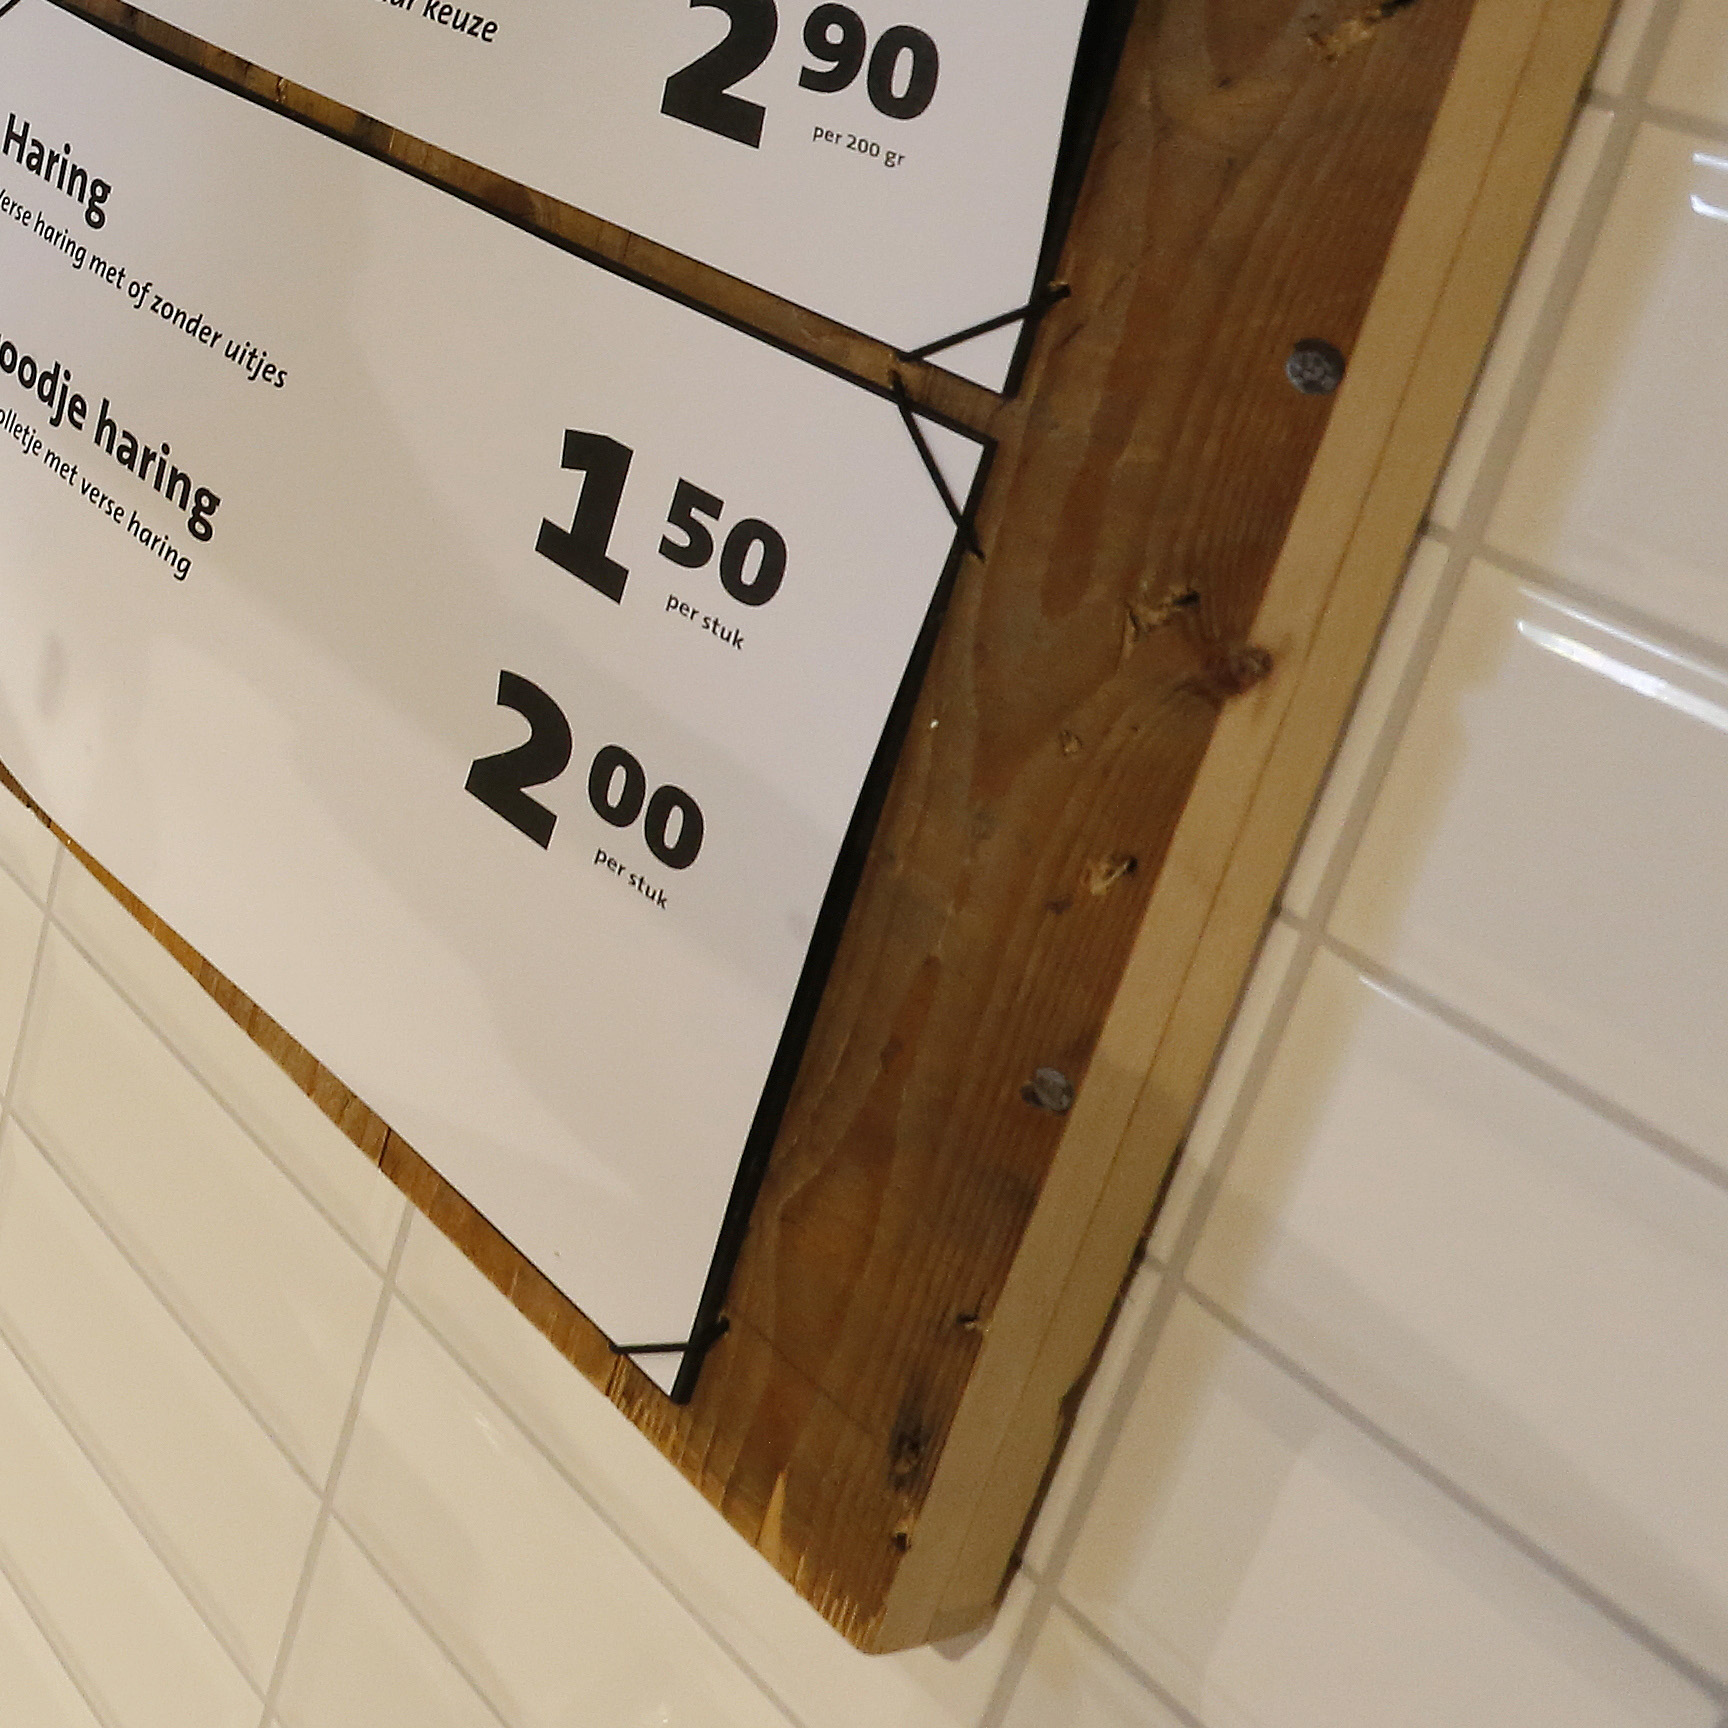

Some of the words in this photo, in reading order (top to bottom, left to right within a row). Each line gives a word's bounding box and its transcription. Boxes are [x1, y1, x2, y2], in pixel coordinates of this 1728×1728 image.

[1, 112, 112, 231] Haring
[812, 126, 843, 144] per
[846, 134, 880, 157] 200
[884, 150, 905, 168] gr
[33, 210, 87, 269] haring
[88, 254, 126, 290] met
[127, 280, 153, 310] of
[150, 294, 223, 348] zonder
[224, 340, 288, 388] uitjes
[43, 448, 78, 486] met
[81, 477, 125, 524] verse
[127, 510, 192, 582] haring
[93, 398, 221, 543] haring
[665, 594, 699, 621] per
[701, 616, 744, 650] stuk
[594, 848, 626, 876] per
[628, 873, 668, 909] stuk
